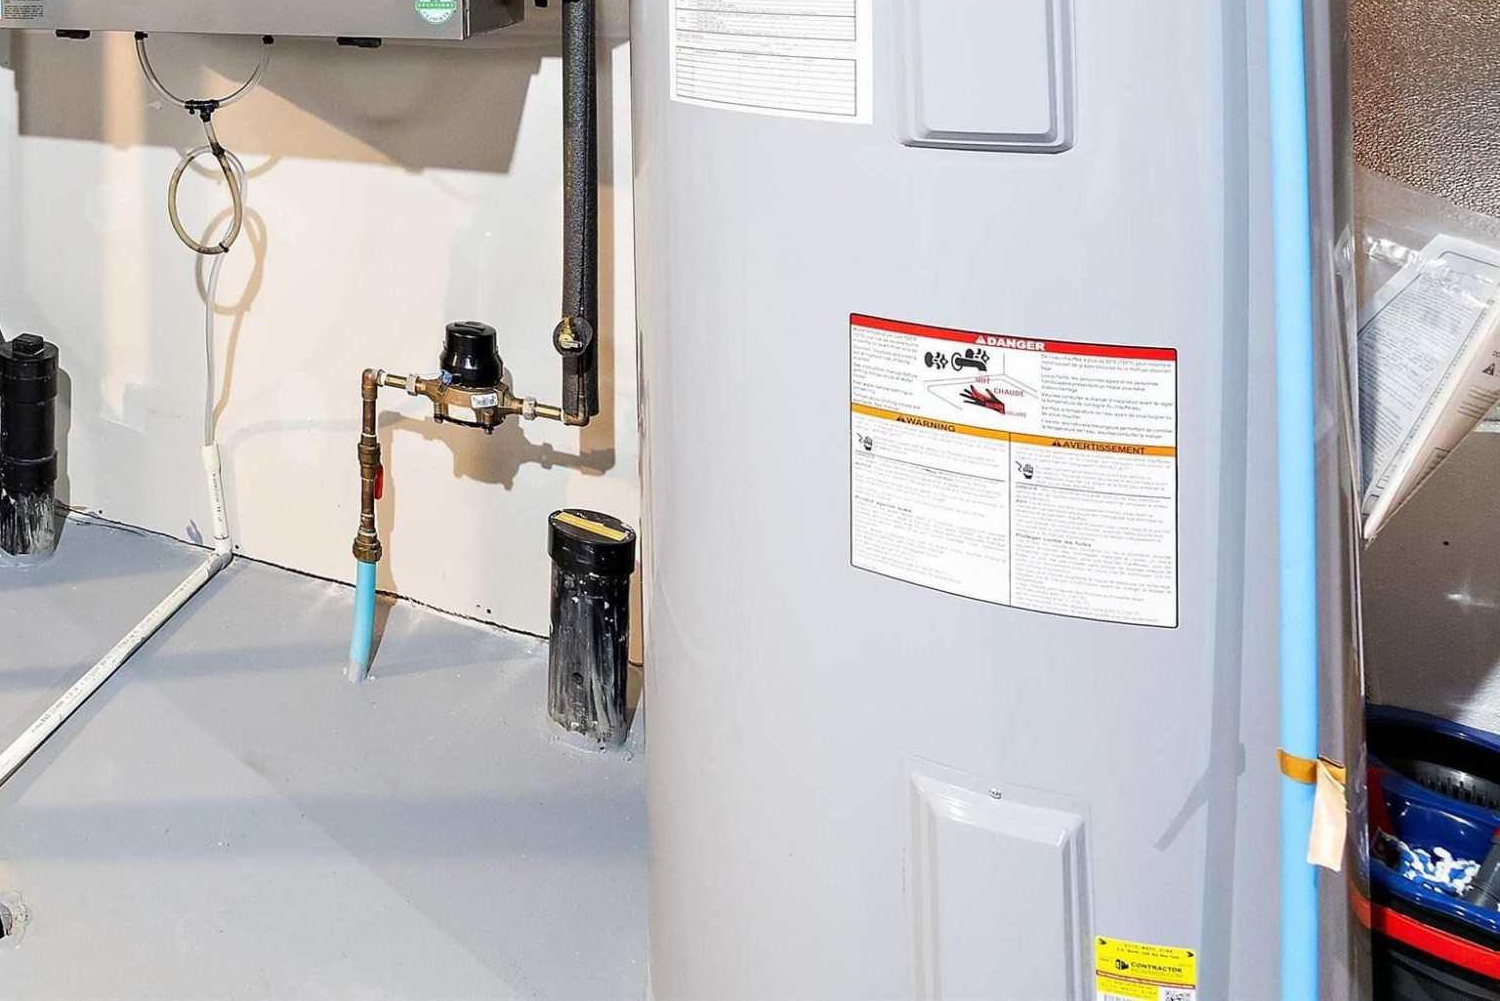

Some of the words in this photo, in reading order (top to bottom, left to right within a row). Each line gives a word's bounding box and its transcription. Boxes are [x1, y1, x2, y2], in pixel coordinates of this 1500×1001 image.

[987, 335, 1046, 352] DANGER
[993, 387, 1025, 397] CHAUDE
[906, 417, 956, 432] WARNING
[1063, 440, 1147, 455] AVERTISSEMENT
[1130, 961, 1183, 973] CONTRACTOR
